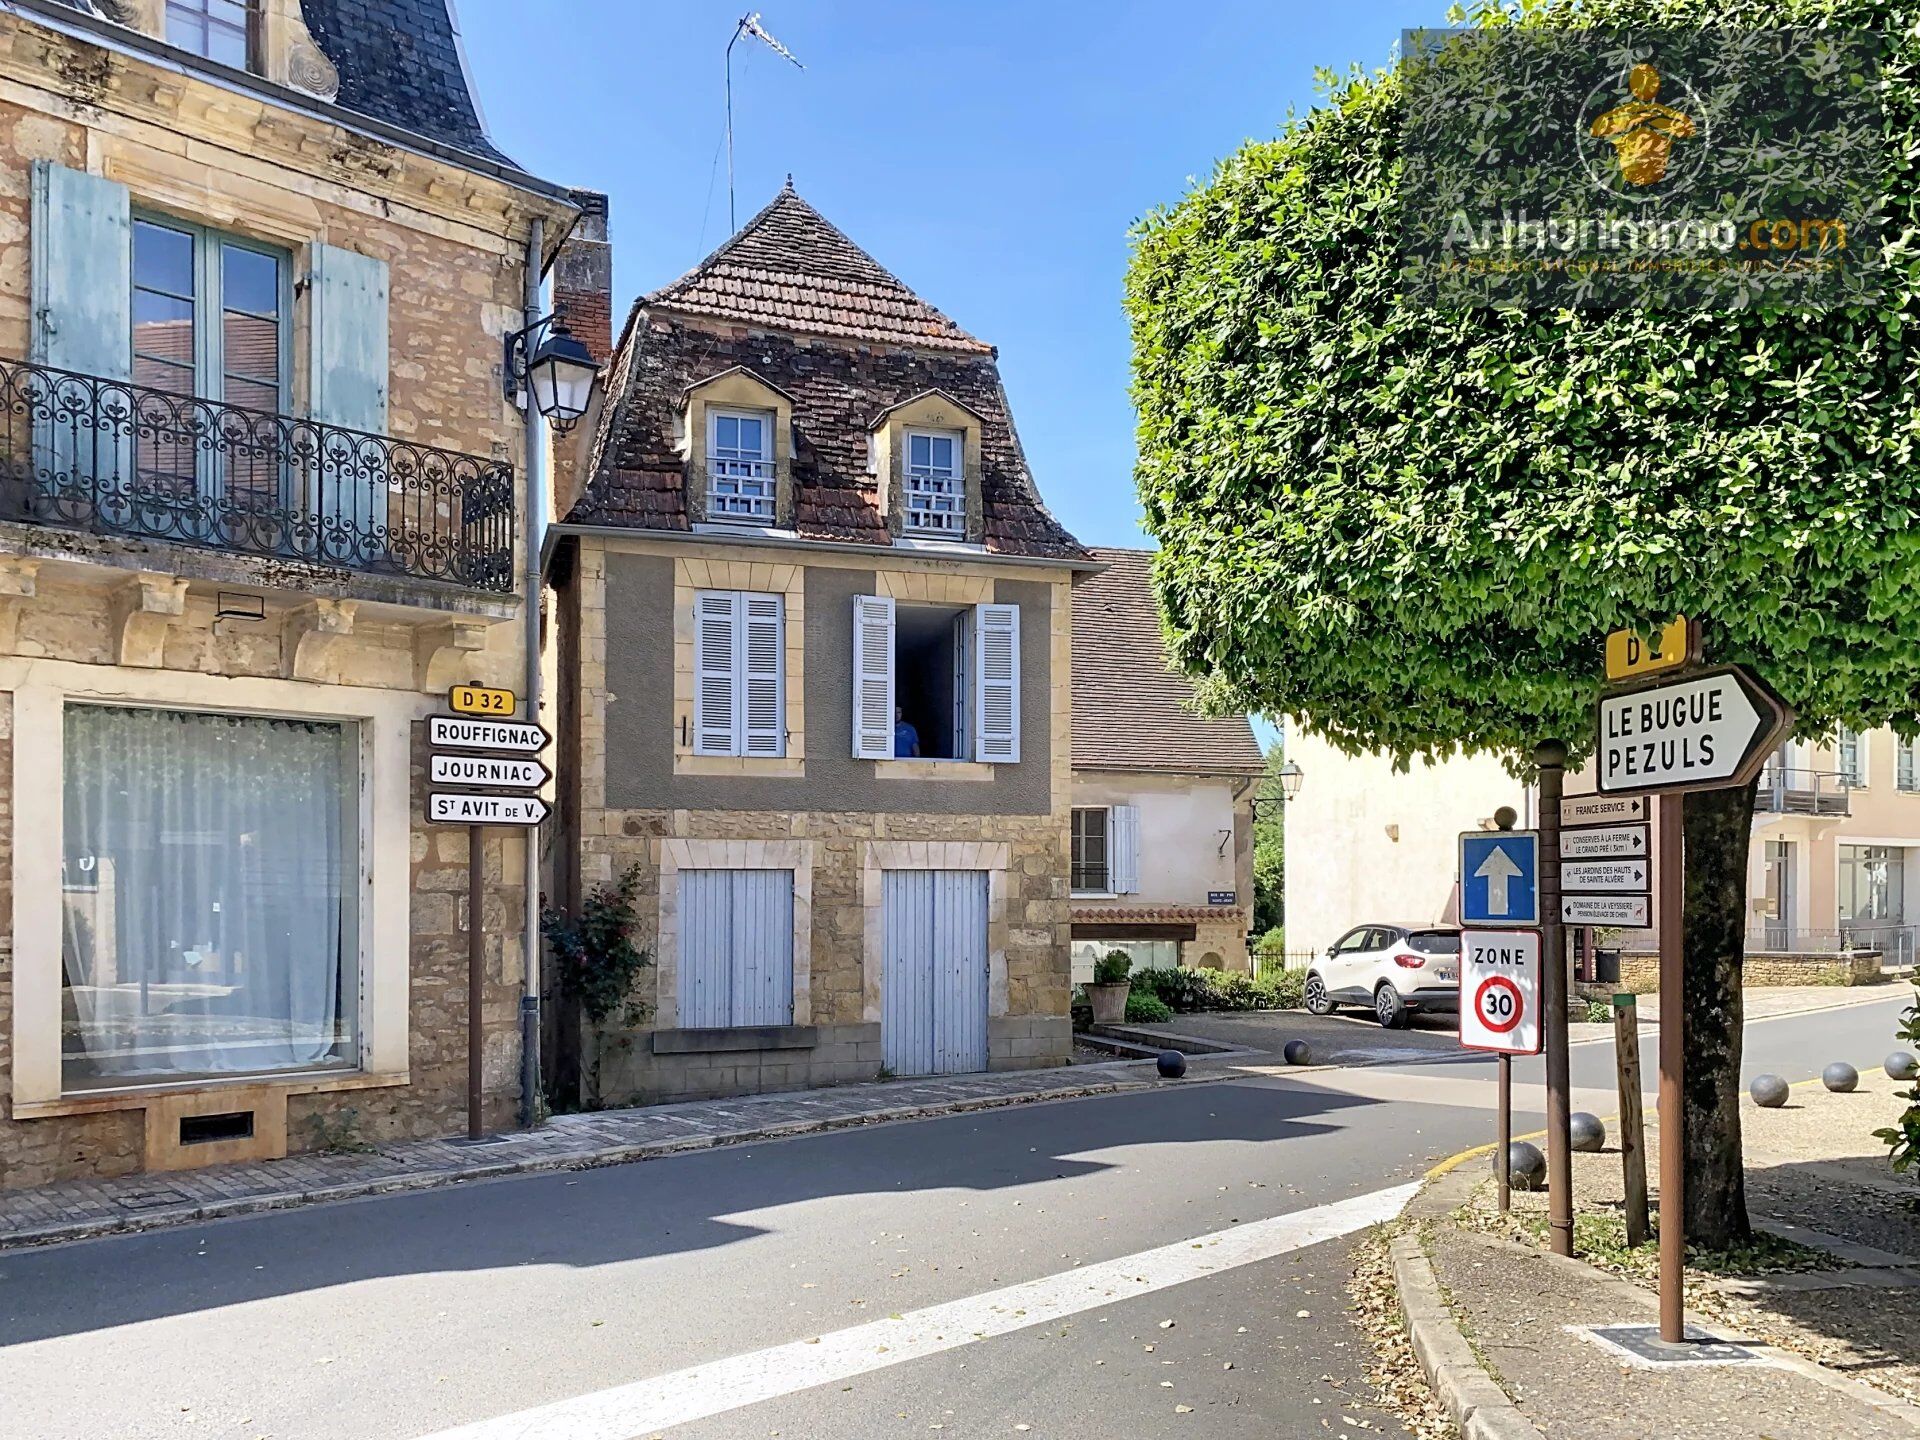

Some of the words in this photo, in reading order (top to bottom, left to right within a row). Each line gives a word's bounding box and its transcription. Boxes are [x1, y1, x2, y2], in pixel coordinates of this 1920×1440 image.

[1627, 637, 1640, 666] D
[463, 691, 474, 707] D
[480, 693, 504, 710] 32
[1608, 707, 1632, 739] LE
[1641, 688, 1722, 734] BUGUE
[437, 723, 540, 746] ROUFFIGNAC
[1609, 734, 1714, 778] PEZULS
[438, 761, 532, 781] JOURNIAC
[461, 800, 500, 817] AVIT
[524, 803, 540, 818] V.
[1575, 804, 1600, 816] FRANCE
[1600, 802, 1625, 814] SERVICE
[1572, 835, 1600, 845] CONSERVES
[1605, 834, 1611, 843] LA
[1612, 833, 1630, 842] FERME
[1575, 846, 1582, 854] LE
[1582, 845, 1598, 854] GRAND
[1573, 867, 1581, 875] LES
[1582, 866, 1602, 875] JARDINS
[1603, 866, 1613, 875] DES
[1613, 866, 1631, 875] HAUTS
[1579, 875, 1586, 884] DE
[1586, 875, 1604, 883] SAINTE
[1572, 901, 1594, 909] DOMAINE
[1593, 901, 1600, 910] DE
[1601, 902, 1607, 910] LA
[1474, 947, 1525, 966] ZONE
[1486, 993, 1513, 1016] 30
